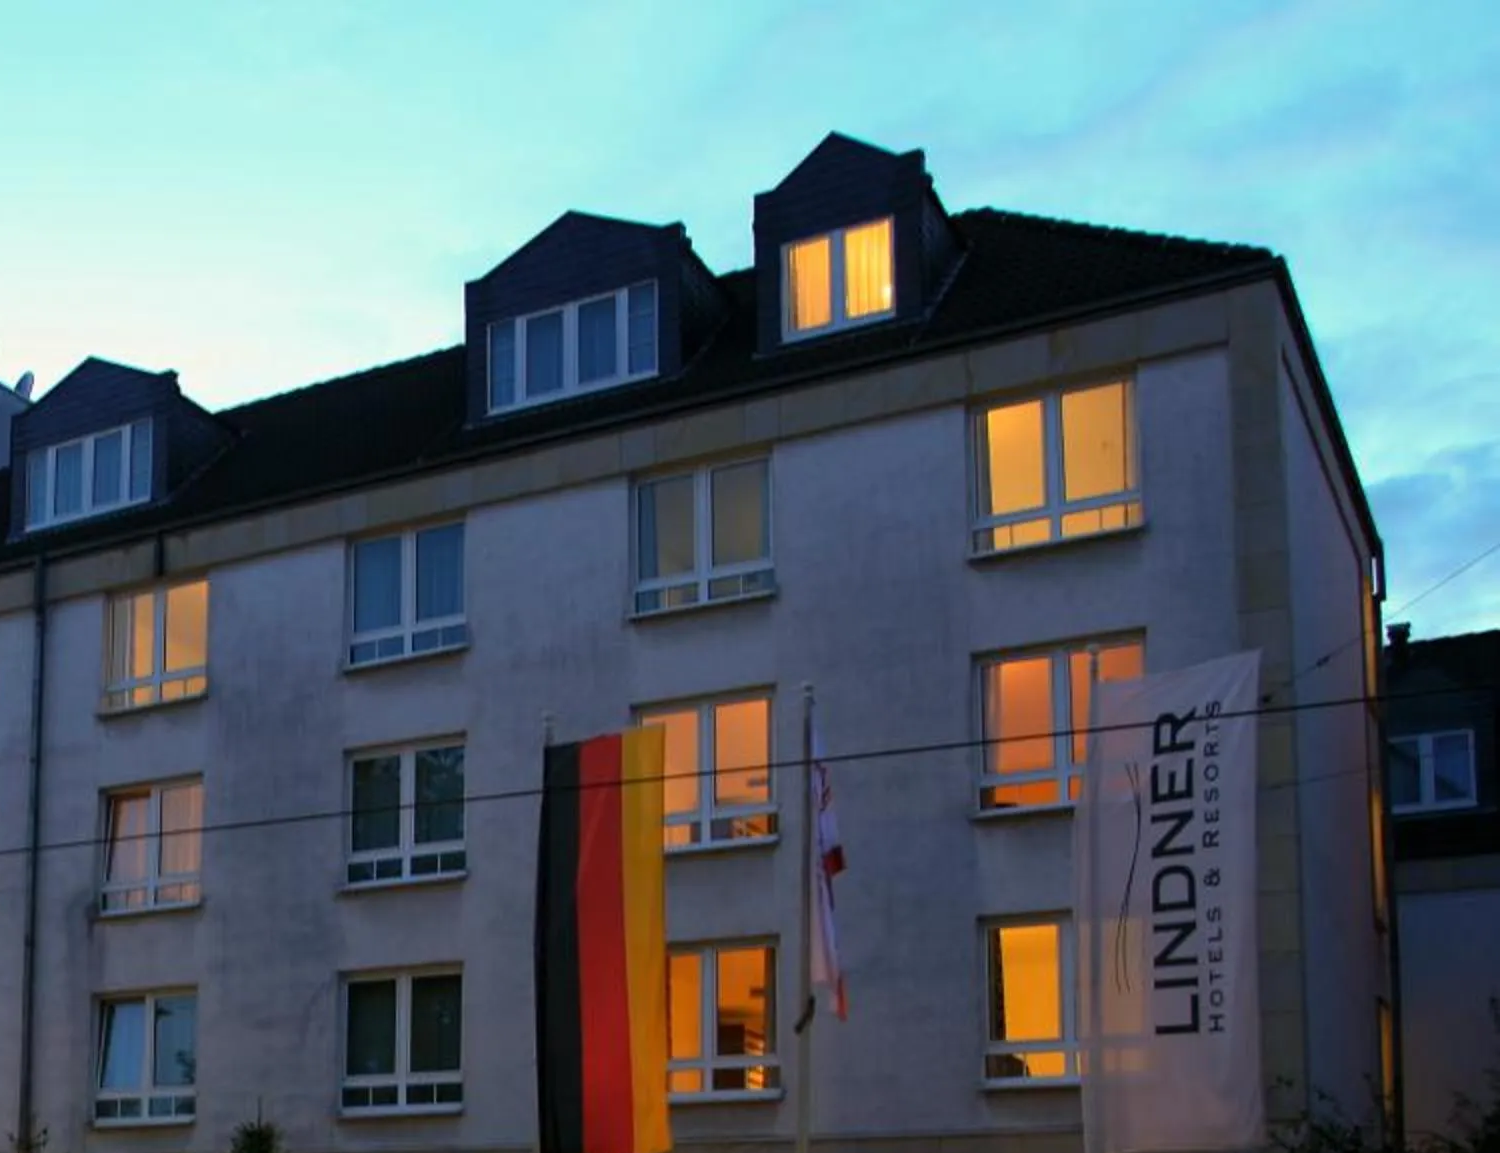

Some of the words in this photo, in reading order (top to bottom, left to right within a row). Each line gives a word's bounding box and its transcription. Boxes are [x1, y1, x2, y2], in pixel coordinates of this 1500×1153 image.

[1201, 700, 1223, 848] RESORTS
[1150, 706, 1200, 1036] LINDNER
[1203, 866, 1222, 887] &
[1207, 906, 1227, 1033] HOTELS
